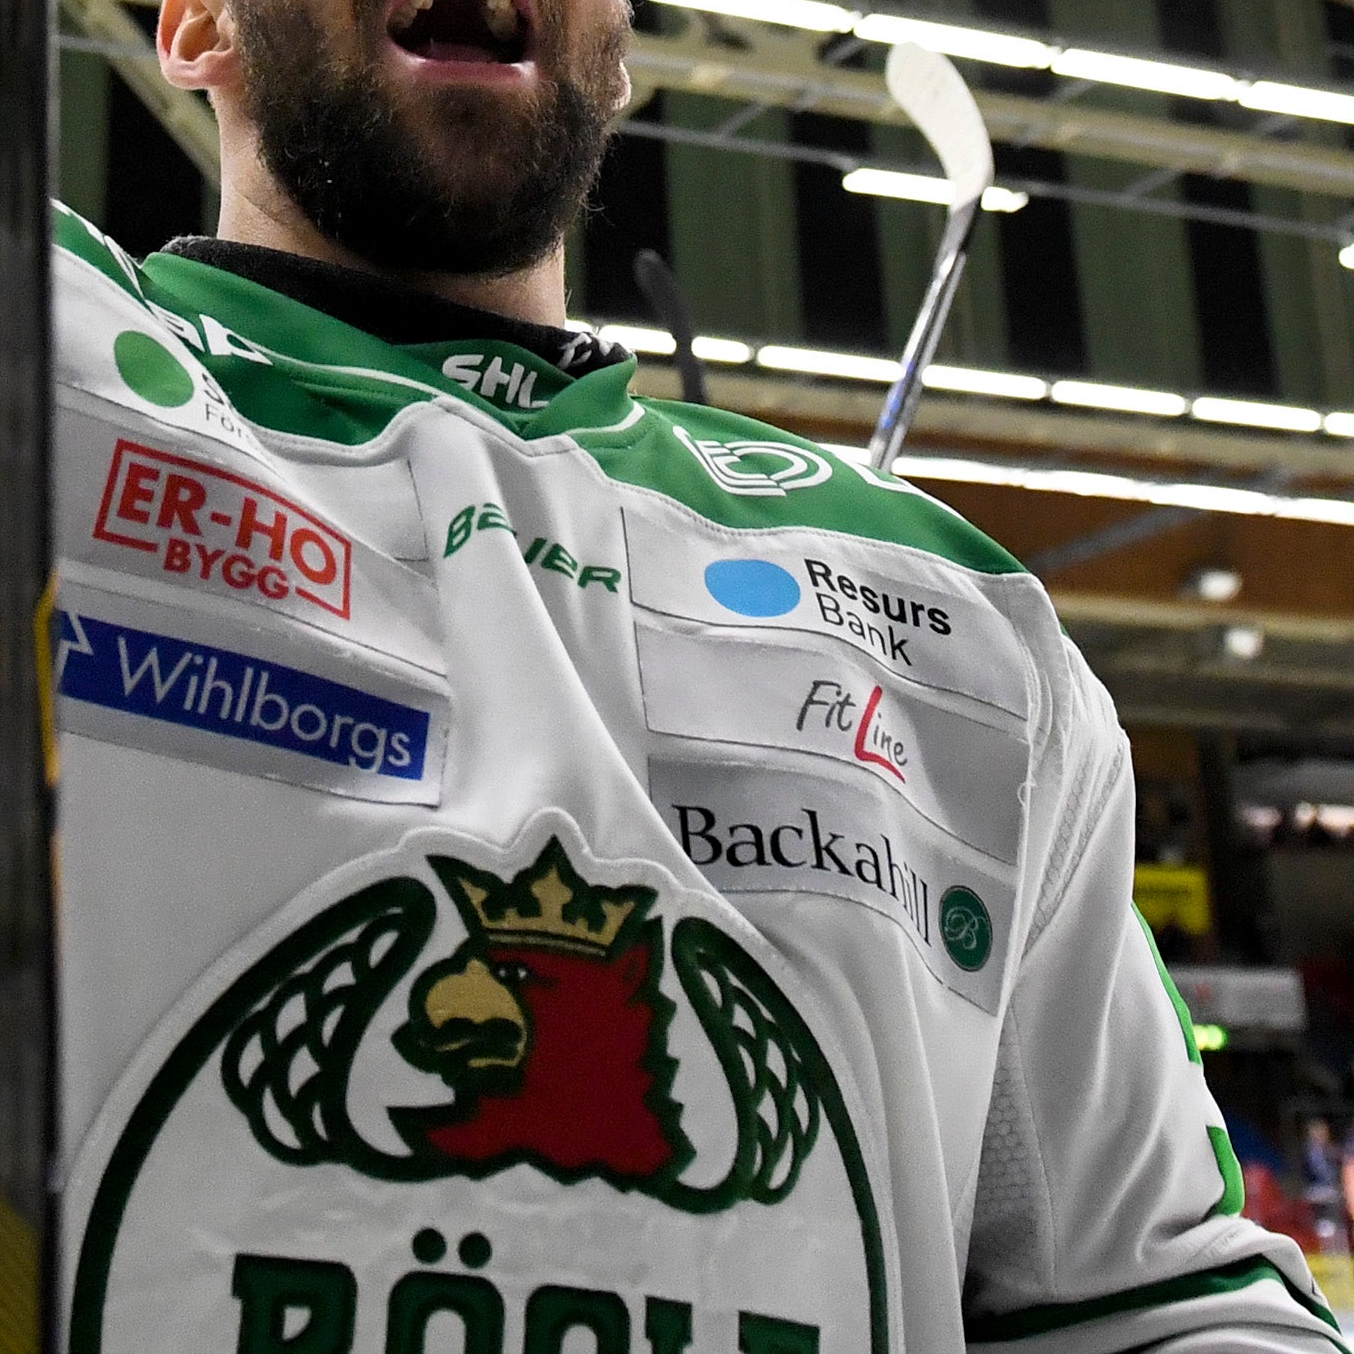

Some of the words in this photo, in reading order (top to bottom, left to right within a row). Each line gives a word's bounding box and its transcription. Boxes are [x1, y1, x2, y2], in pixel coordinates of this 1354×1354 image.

[442, 353, 551, 409] SHL
[116, 462, 337, 586] ER-HO
[163, 538, 289, 600] BYGG
[805, 559, 951, 635] Resurs
[816, 593, 912, 666] Bank
[117, 636, 411, 774] Wihlborgs
[672, 804, 932, 948] Backahill
